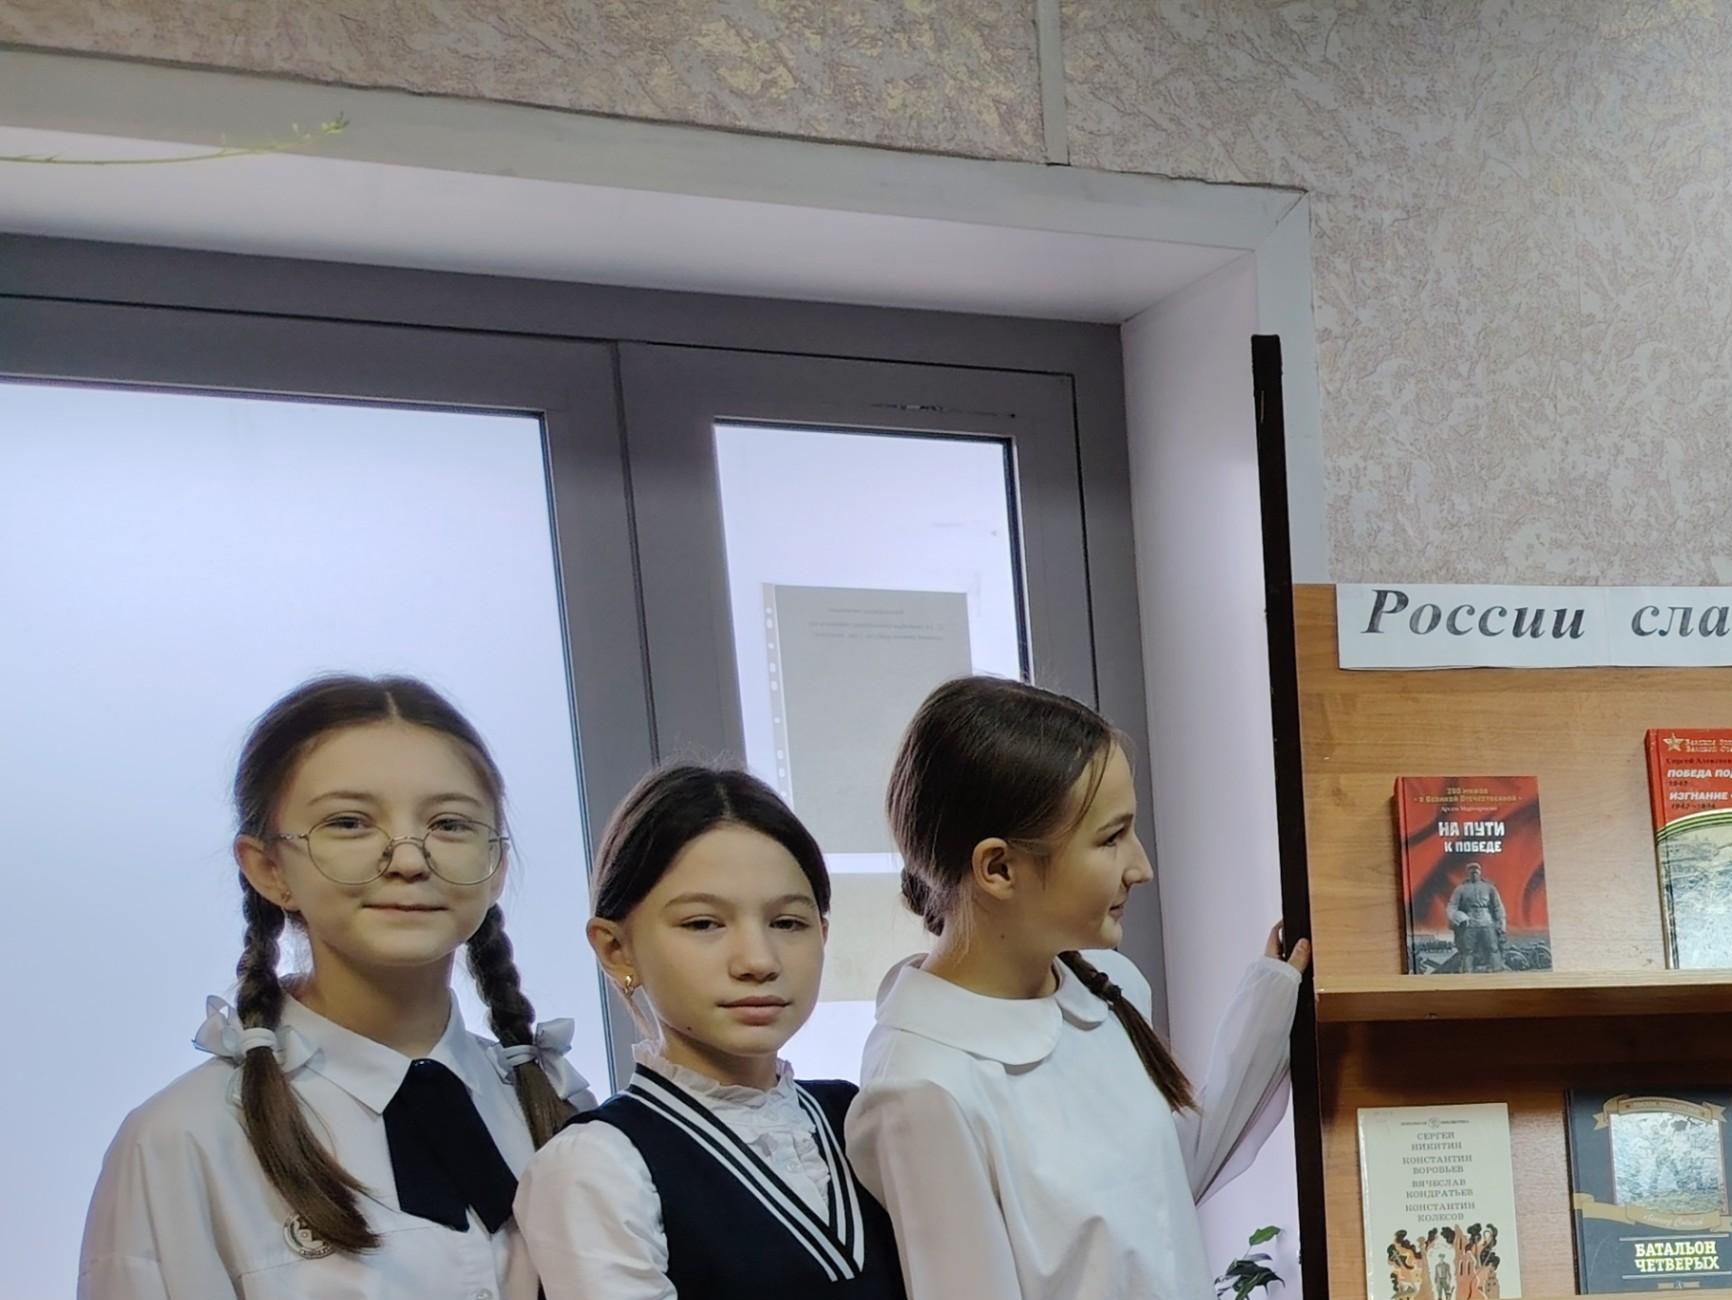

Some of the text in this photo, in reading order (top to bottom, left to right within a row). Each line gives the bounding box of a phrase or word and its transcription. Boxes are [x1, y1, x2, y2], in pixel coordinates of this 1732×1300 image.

[1360, 587, 1586, 640] России
[1667, 768, 1712, 779] ПОБЕДА
[1669, 791, 1729, 801] ИЗГНАНИЕ
[1438, 821, 1505, 837] НА ПУТИ
[1444, 840, 1502, 854] К ПОБЕДЕ
[1416, 1131, 1455, 1142] СЕРГЕЙ
[1411, 1141, 1463, 1152] НИКИТИН
[1402, 1154, 1473, 1166] КОНСТАНТИН
[1412, 1165, 1464, 1176] ВОРОБЬЕВ
[1412, 1178, 1466, 1189] ВЯЧЕСЛАВ
[1406, 1188, 1474, 1200] КОНДРАТЬЕВ
[1405, 1201, 1476, 1213] КОНСТАНТИН
[1417, 1212, 1464, 1223] КОЛЕСОВ
[1634, 1240, 1717, 1257] БАТАЛЬОН
[1634, 1256, 1720, 1273] ЧЕТВЕРЫХ
